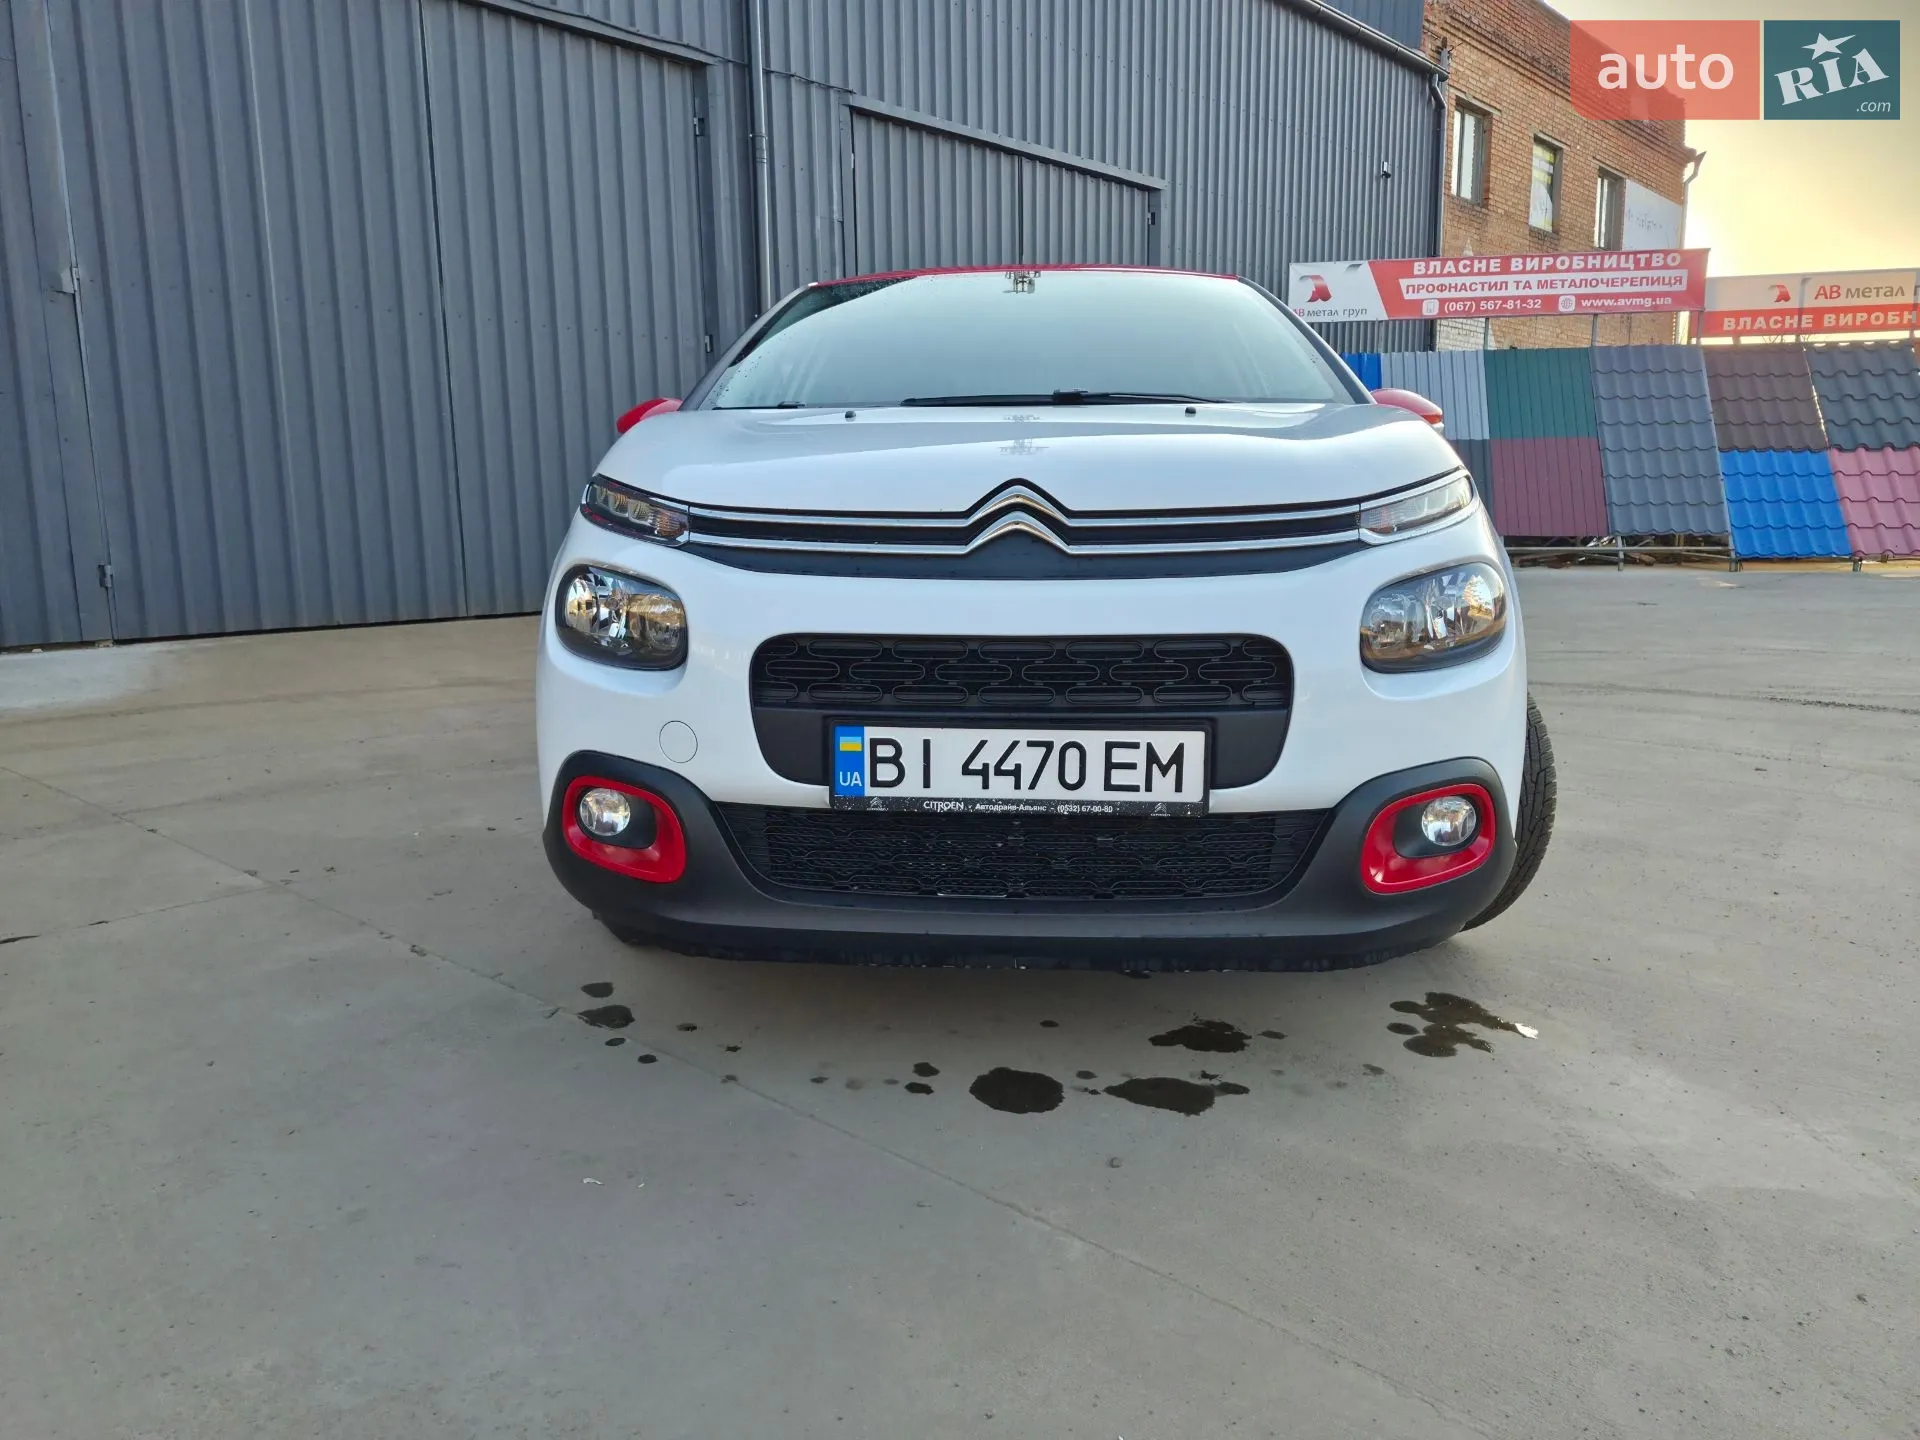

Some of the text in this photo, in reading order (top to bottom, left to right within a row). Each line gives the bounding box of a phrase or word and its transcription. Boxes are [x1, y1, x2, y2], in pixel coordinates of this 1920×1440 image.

[1413, 252, 1681, 275] ВЛАСНЕ ВИРОБНИЦТВО
[1405, 275, 1683, 294] ПРОФНАСТИЛ ТА МЕТАЛОЧЕРЕПИЦЯ
[1814, 284, 1841, 300] АВ
[1845, 285, 1905, 299] метал
[1444, 299, 1542, 314] (067) 567-81-32
[1581, 296, 1672, 307] www.avmg.ua
[1307, 309, 1339, 317] метал
[1343, 308, 1368, 319] груп
[1723, 310, 1917, 331] ВЛАСНЕ ВИРОБН
[961, 739, 1087, 791] 4470
[1103, 740, 1185, 793] EM
[839, 771, 862, 787] UA
